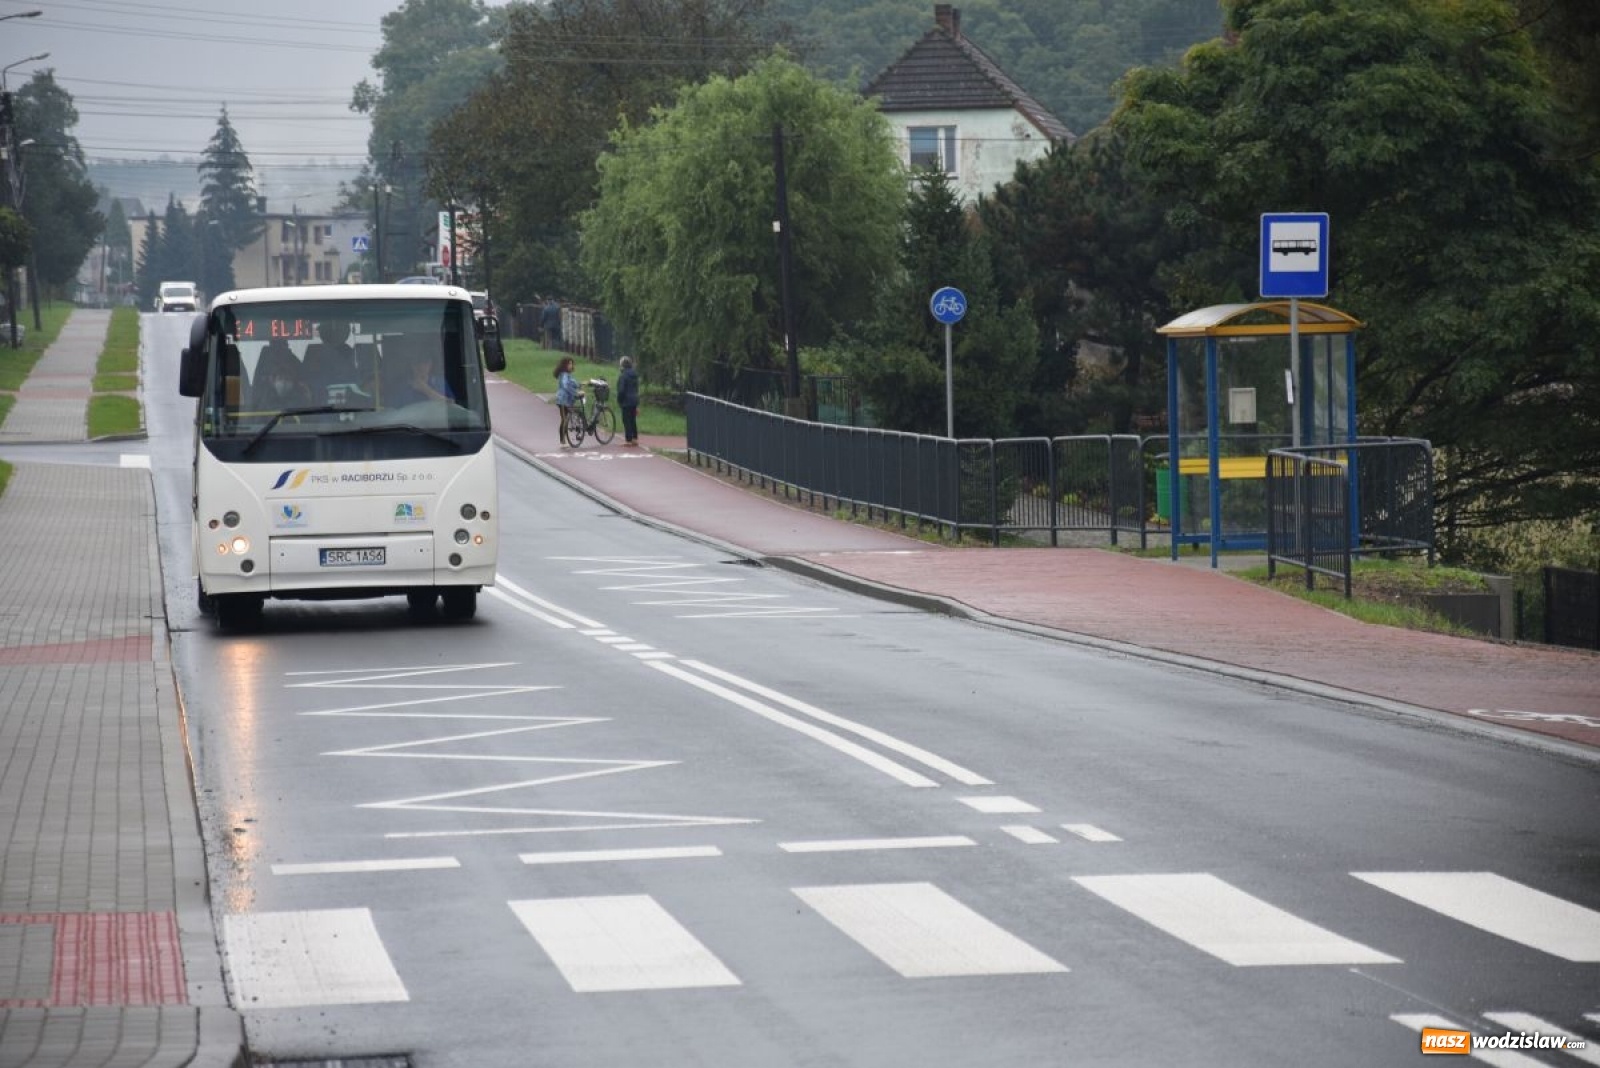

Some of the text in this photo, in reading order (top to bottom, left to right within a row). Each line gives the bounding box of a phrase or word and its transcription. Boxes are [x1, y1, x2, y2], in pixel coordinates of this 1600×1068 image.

[311, 475, 329, 483] PKS
[341, 472, 394, 482] RACIBORZU
[328, 551, 352, 562] SRC
